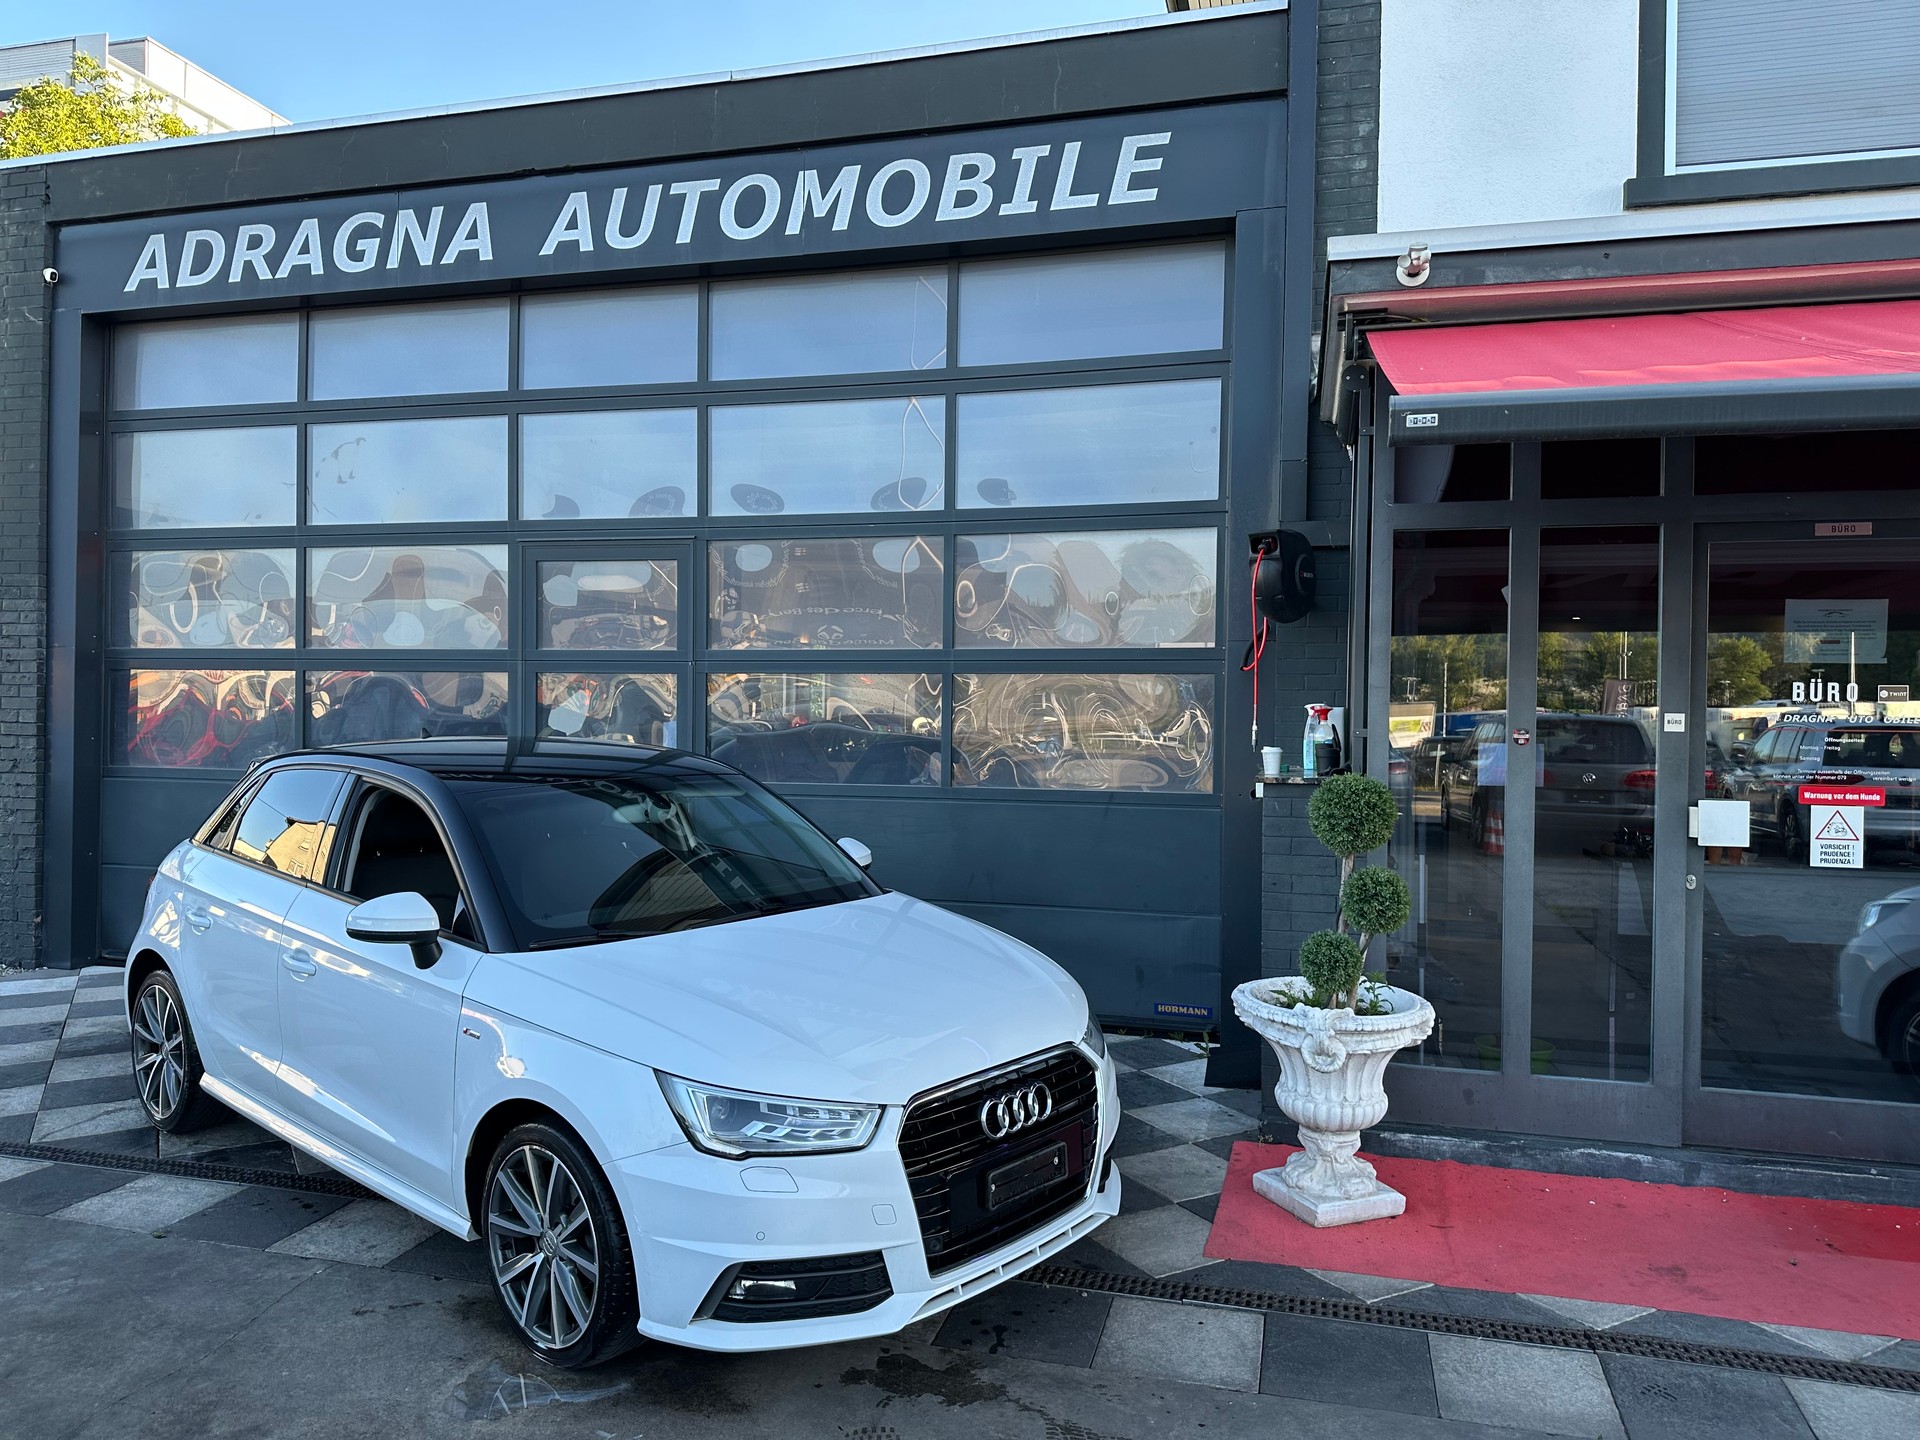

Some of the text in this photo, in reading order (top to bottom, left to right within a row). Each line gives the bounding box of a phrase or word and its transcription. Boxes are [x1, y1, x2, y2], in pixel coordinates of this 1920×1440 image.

[124, 131, 1172, 293] ADRAGNA AUTOMOBILE
[1831, 524, 1856, 533] BÜRO
[1792, 679, 1859, 702] BÜRO
[1803, 791, 1832, 800] Warnung
[1845, 792, 1859, 800] dem
[1860, 793, 1881, 801] Hunde
